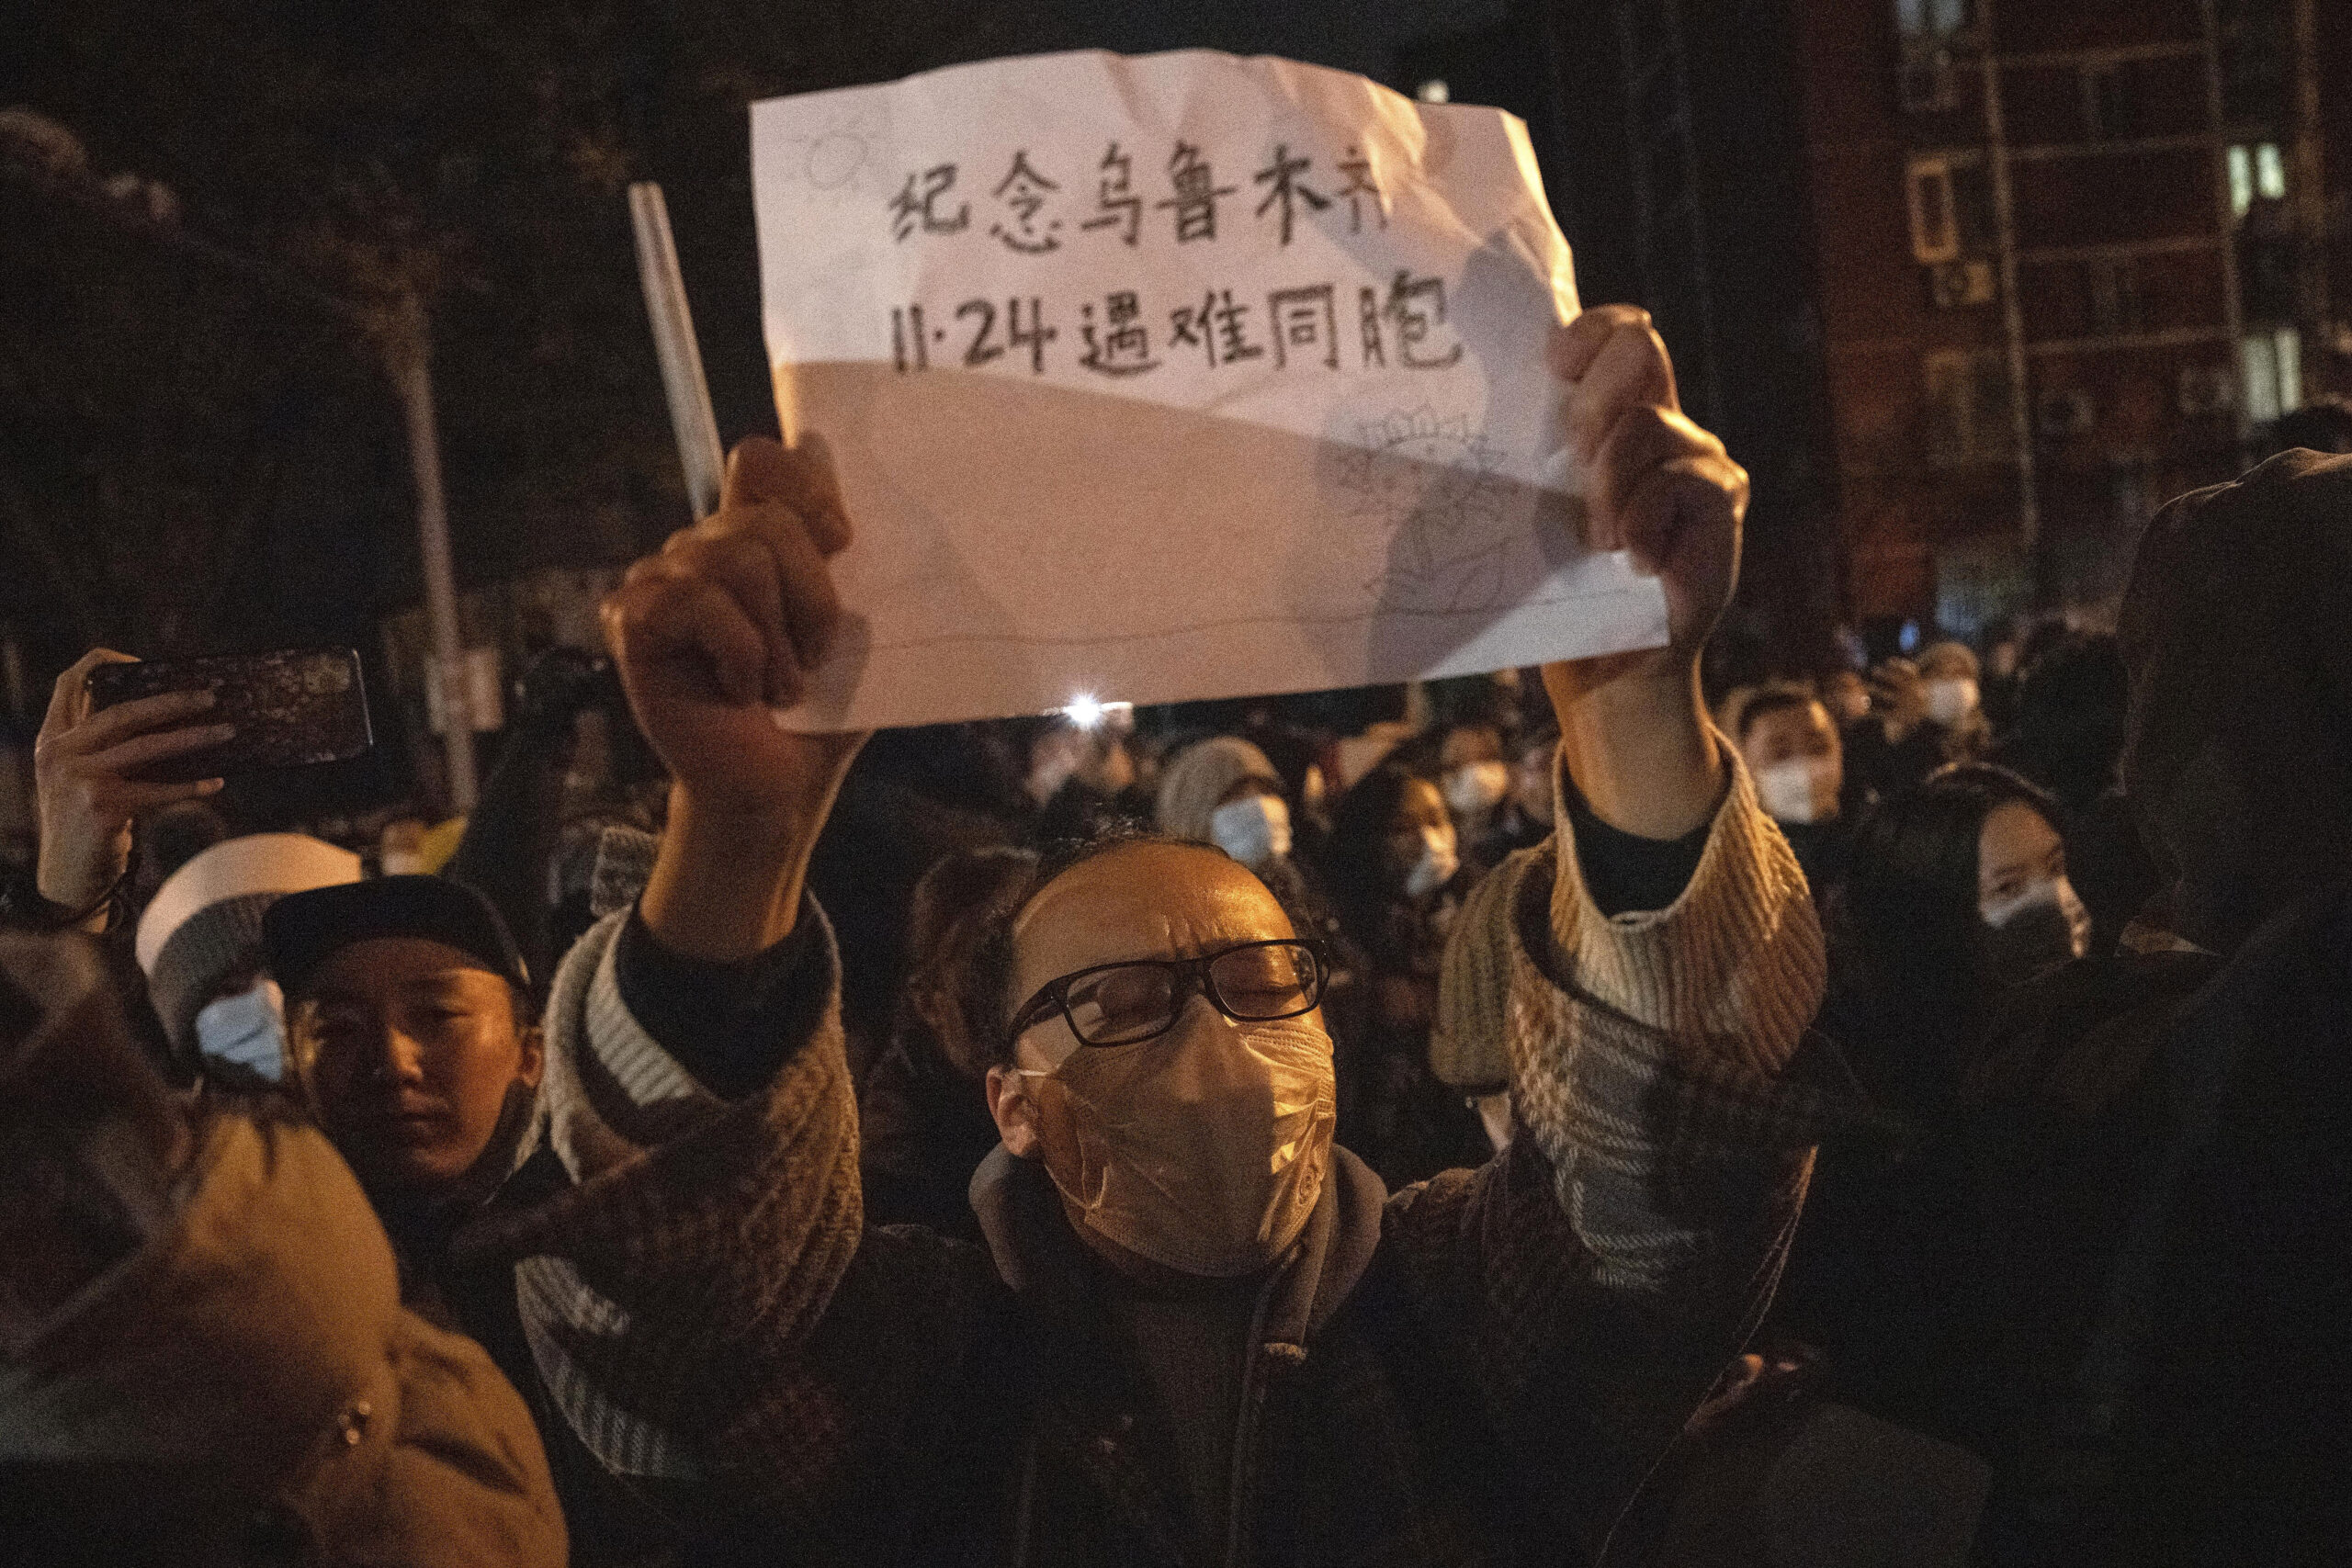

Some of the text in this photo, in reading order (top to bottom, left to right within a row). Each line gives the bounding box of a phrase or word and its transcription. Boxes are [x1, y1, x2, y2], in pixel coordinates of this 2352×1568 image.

[888, 140, 1389, 254] 纪念乌鲁木齐
